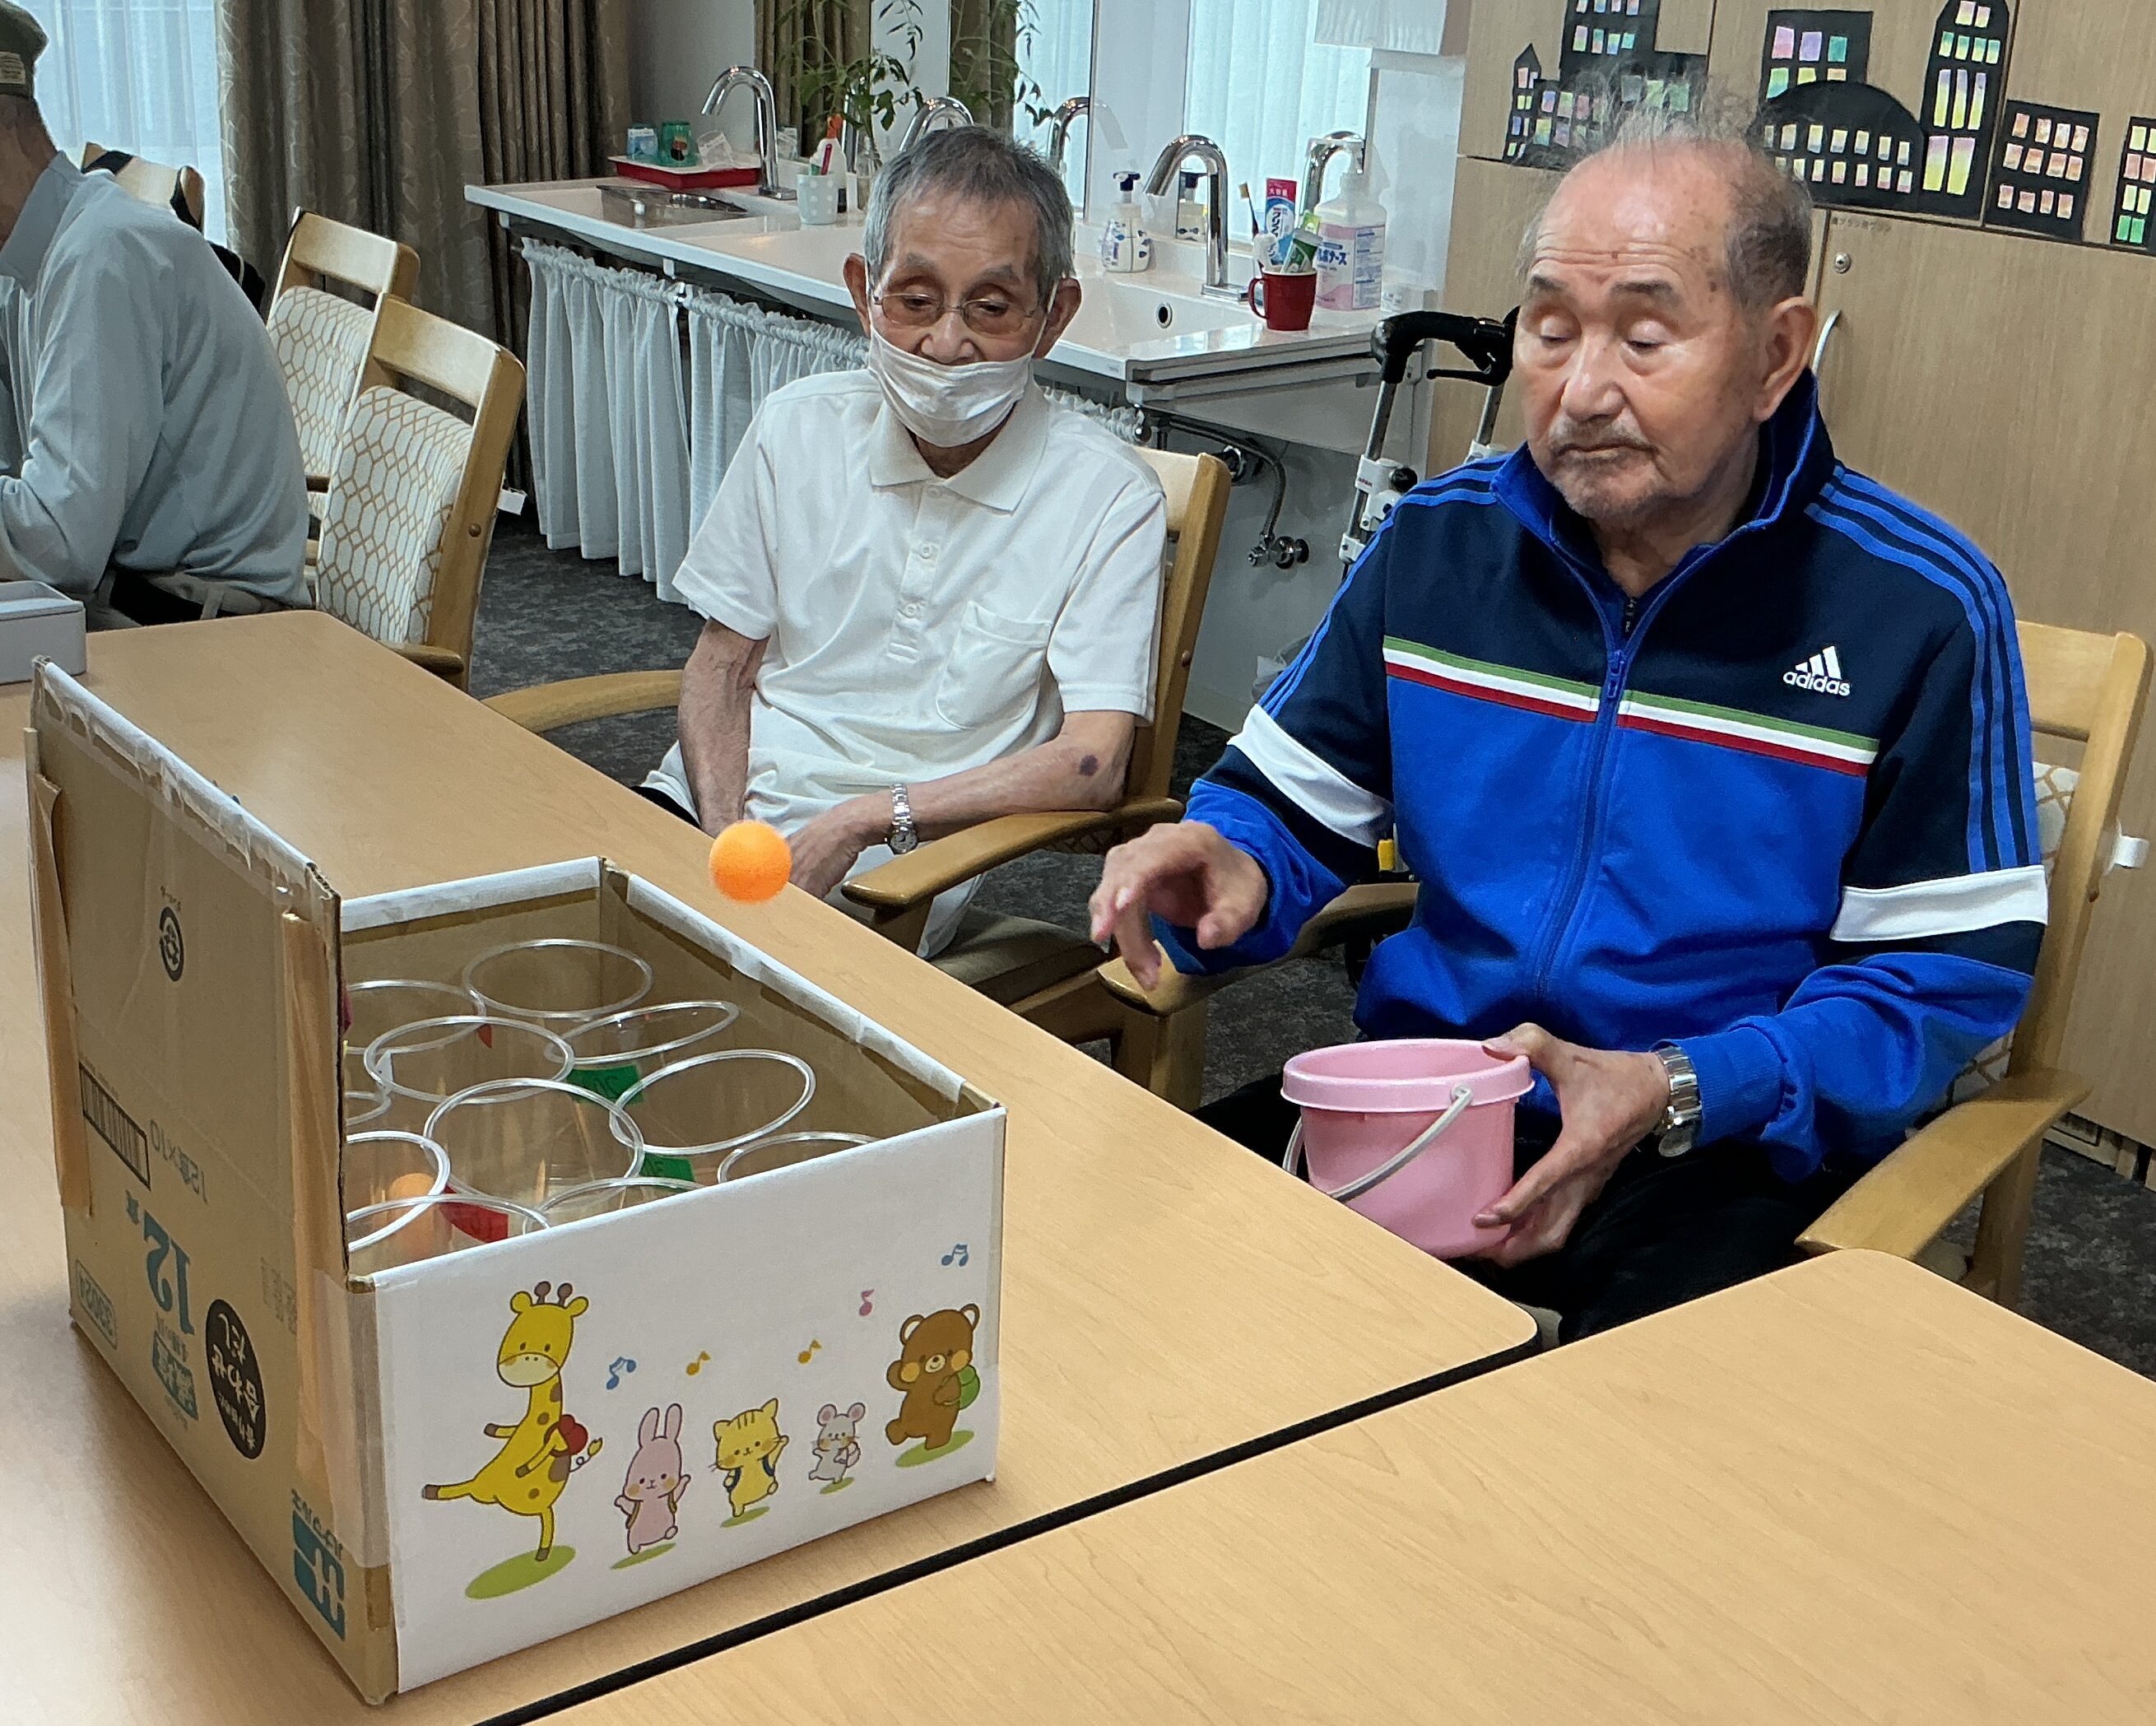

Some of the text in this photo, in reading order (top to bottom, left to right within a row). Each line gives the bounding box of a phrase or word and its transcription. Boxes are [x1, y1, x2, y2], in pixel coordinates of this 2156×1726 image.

[1782, 671, 1851, 696] adidas
[217, 1313, 246, 1364] だし
[211, 1344, 260, 1423] 合わせ
